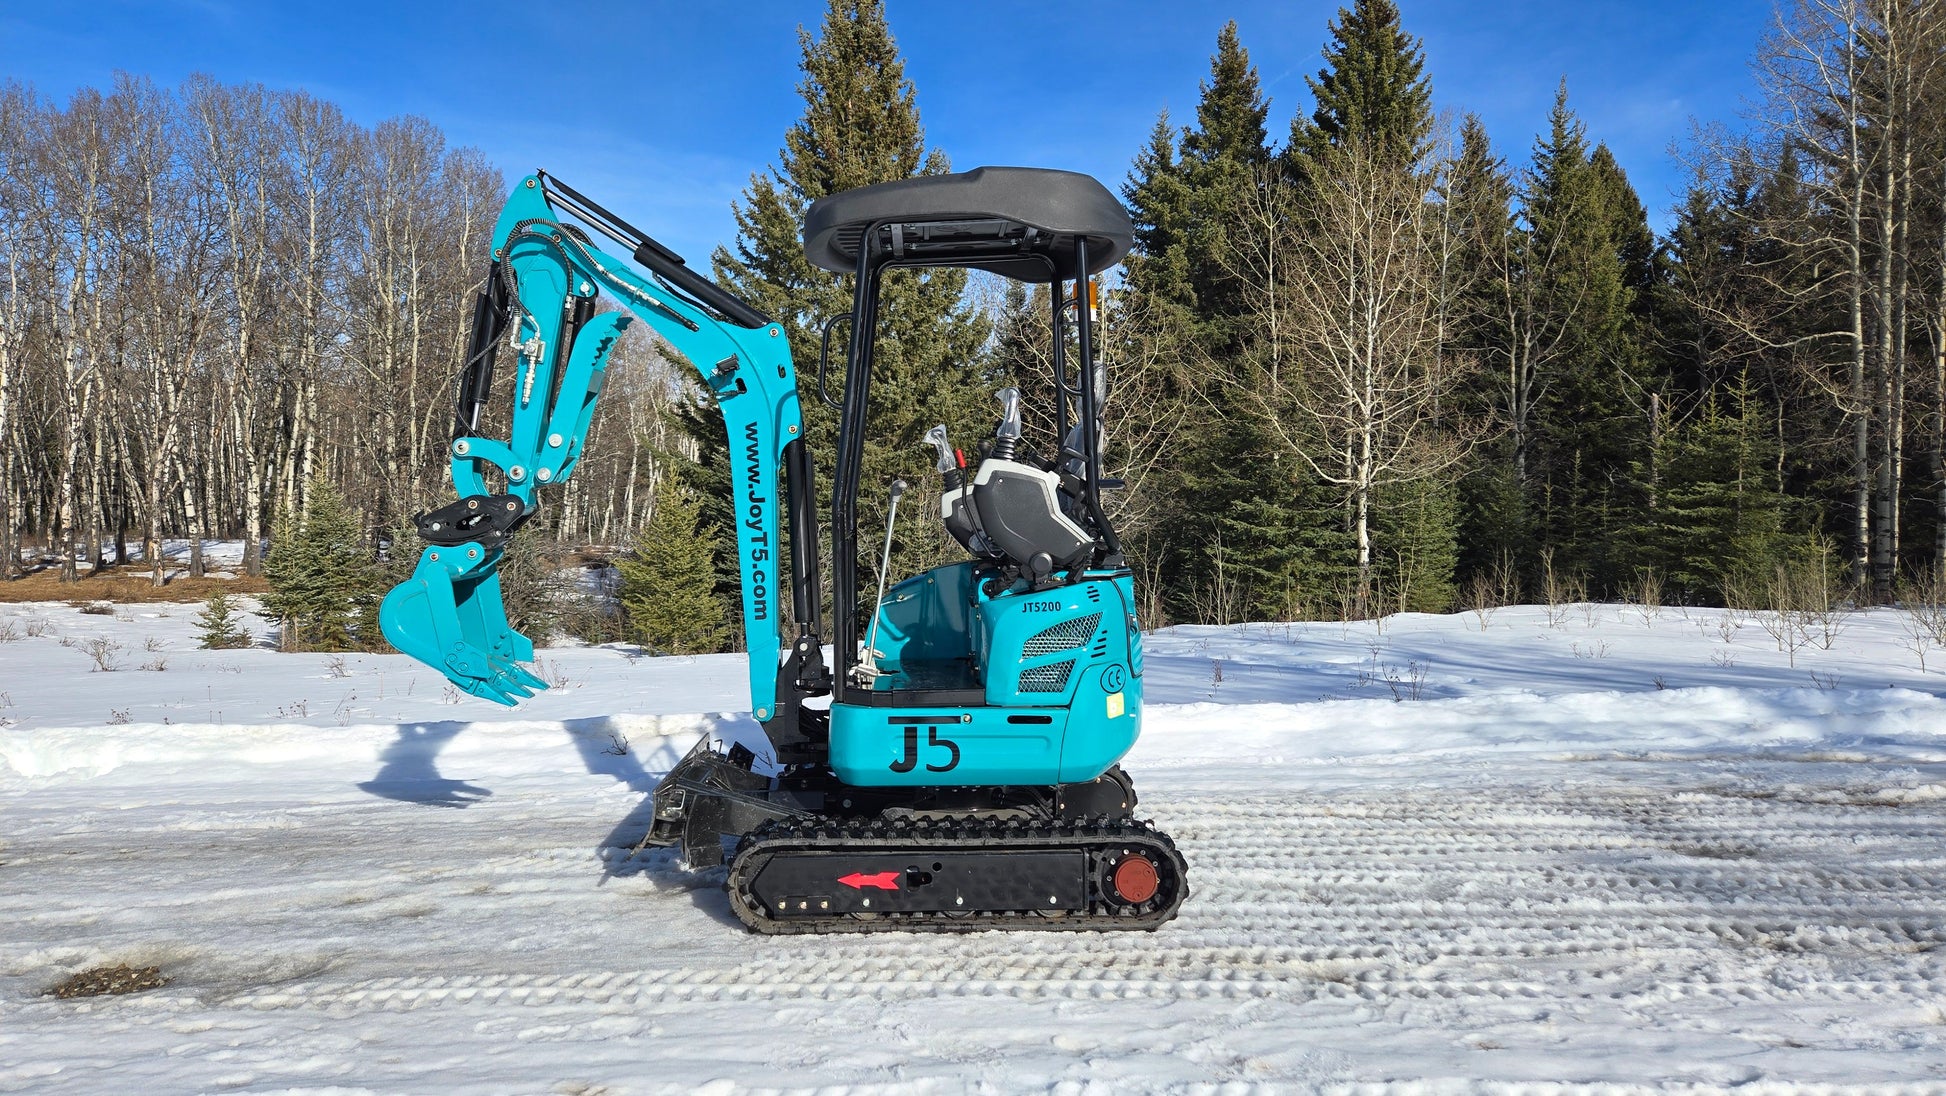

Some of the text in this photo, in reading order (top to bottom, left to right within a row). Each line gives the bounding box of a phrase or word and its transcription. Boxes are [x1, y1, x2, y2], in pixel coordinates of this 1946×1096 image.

[745, 421, 769, 621] www.JoyT5.com
[1022, 601, 1062, 613] JT5200
[1106, 667, 1122, 689] CE
[888, 716, 961, 773] J5
